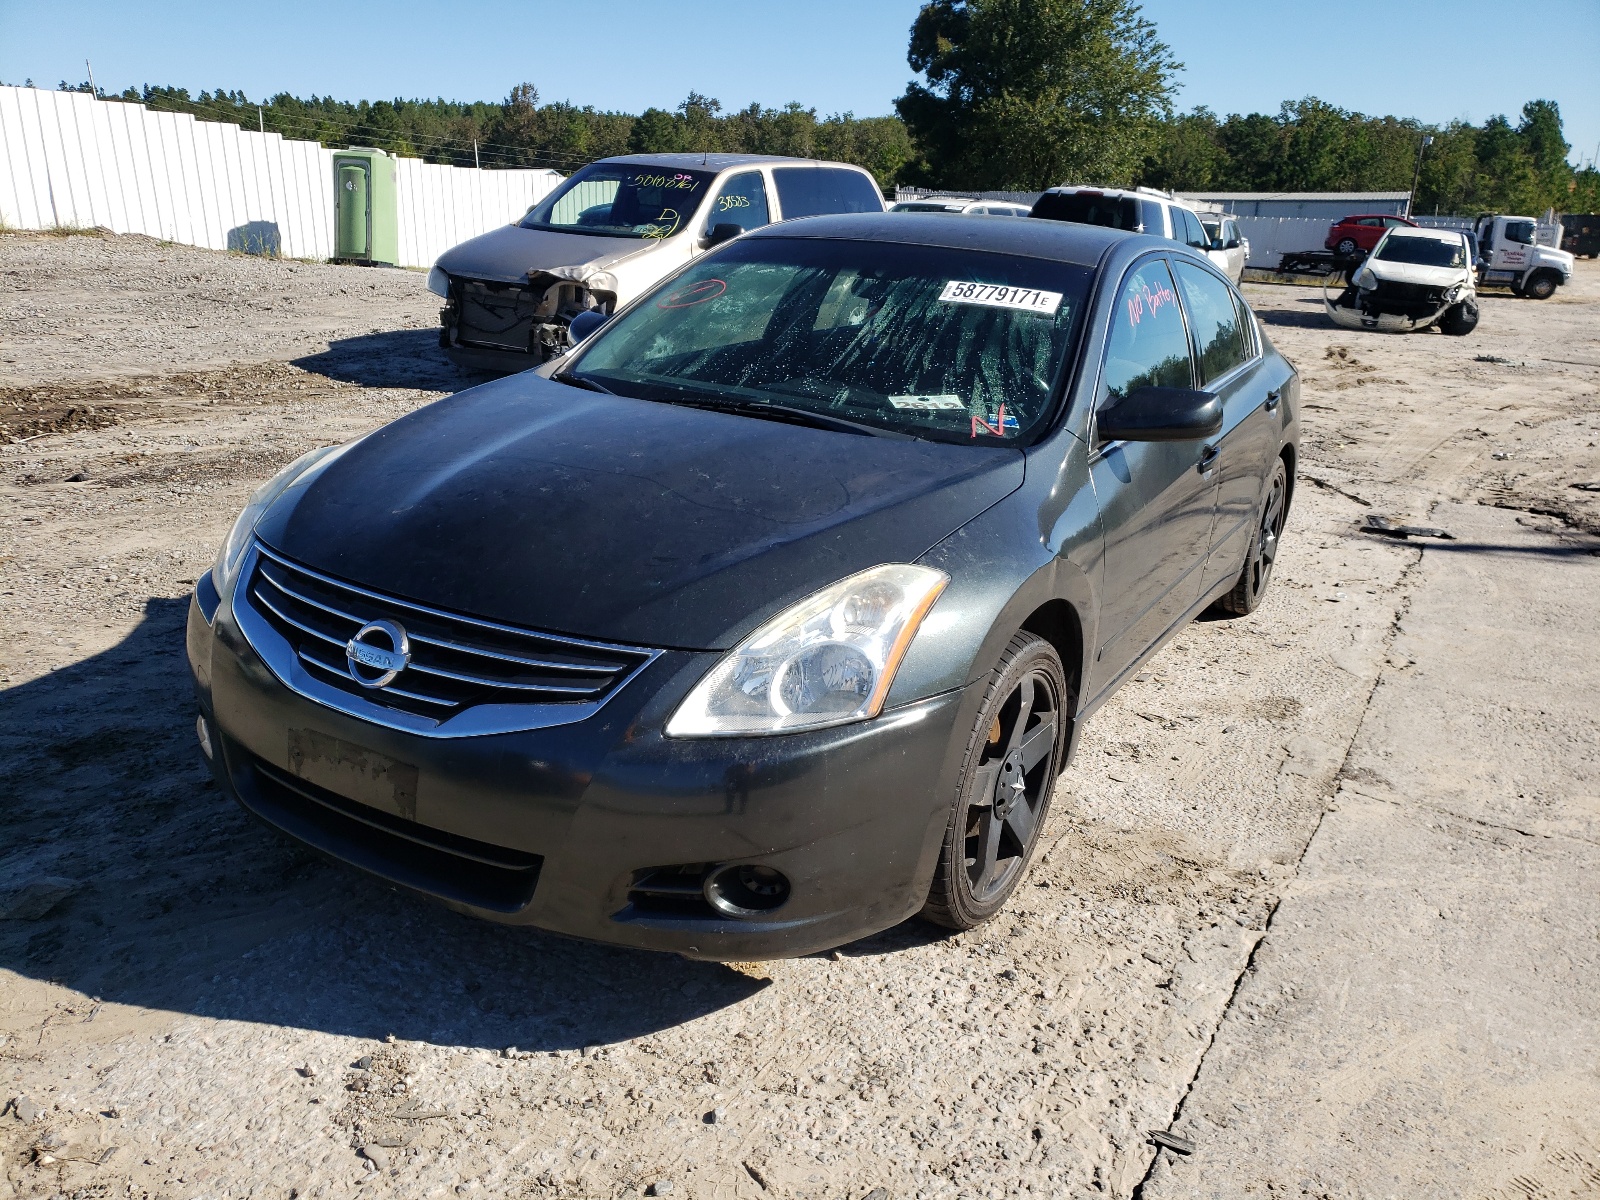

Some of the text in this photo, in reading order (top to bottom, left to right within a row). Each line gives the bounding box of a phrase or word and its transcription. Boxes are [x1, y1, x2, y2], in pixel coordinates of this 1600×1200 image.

[951, 282, 1041, 306] 58779171
[1040, 297, 1050, 306] E
[970, 402, 1005, 439] N
[347, 643, 394, 668] NISSAN
